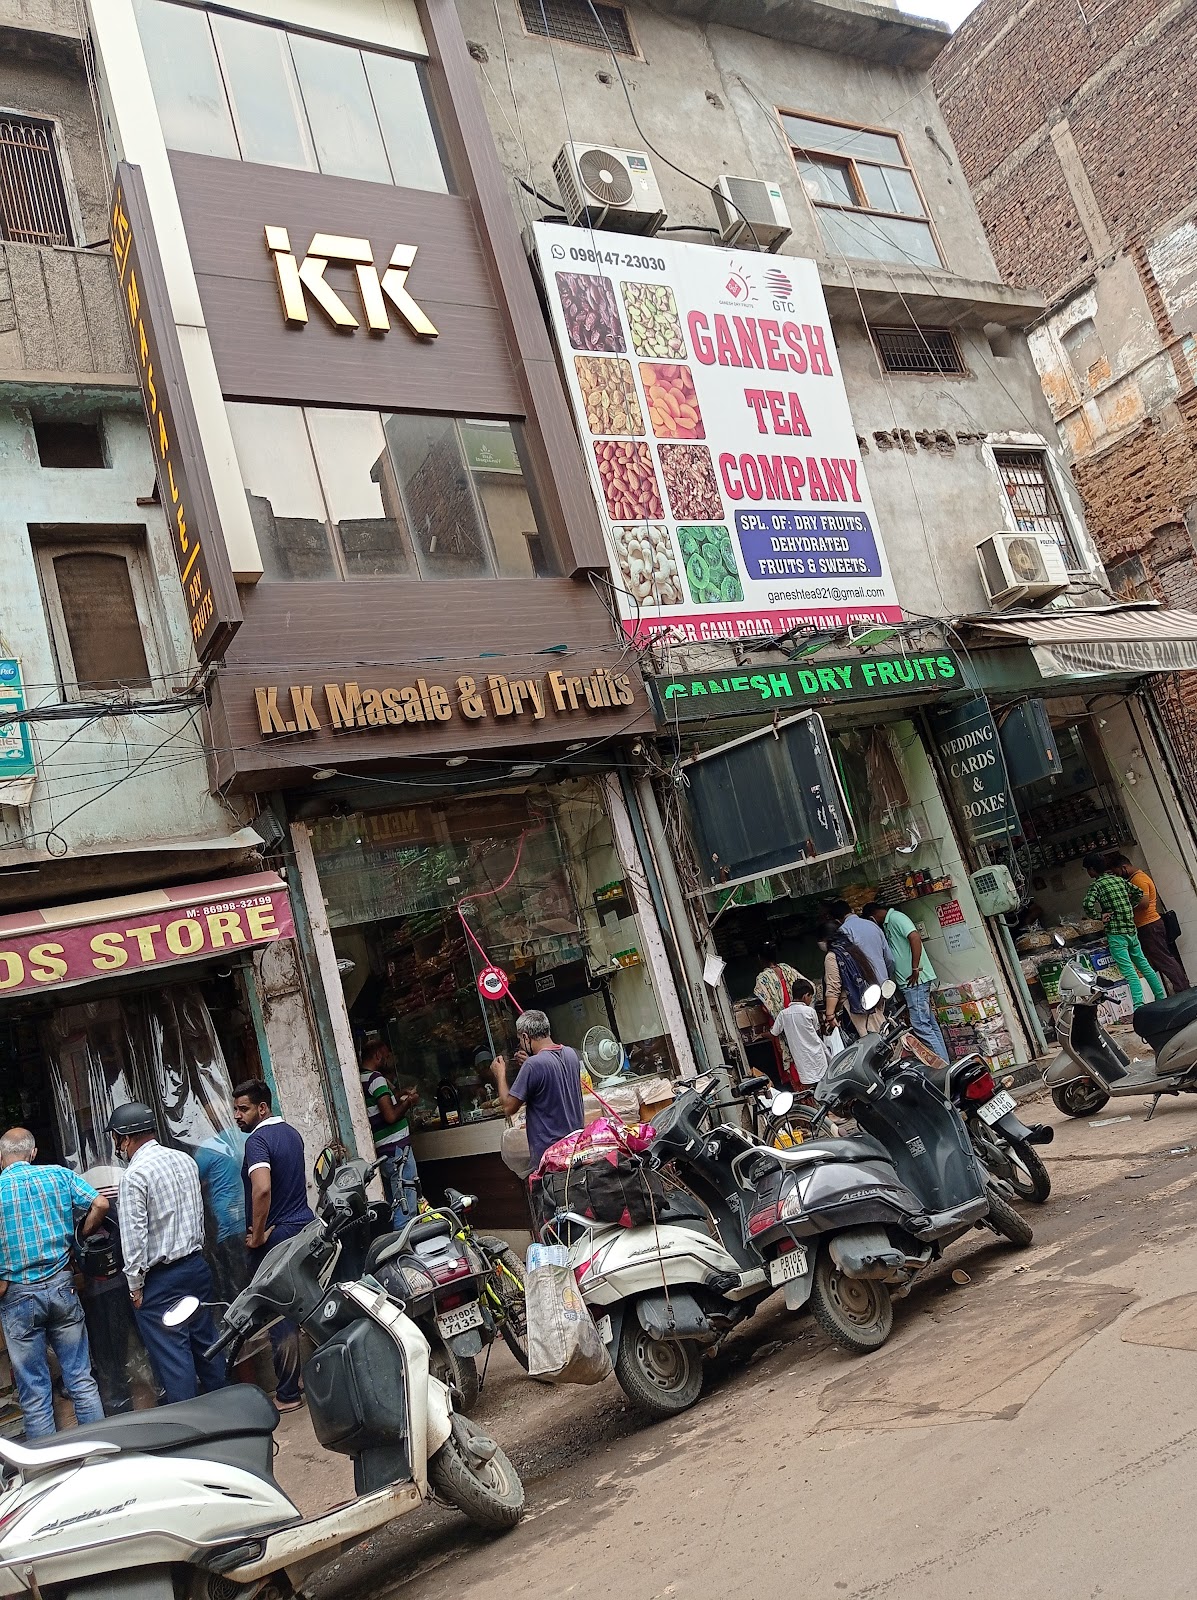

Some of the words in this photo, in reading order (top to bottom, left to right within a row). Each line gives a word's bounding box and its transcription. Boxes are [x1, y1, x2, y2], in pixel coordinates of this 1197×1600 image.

[569, 247, 666, 271] 098147-23030
[772, 300, 796, 313] GTC
[687, 309, 834, 377] GANESH
[127, 268, 188, 554] MASALE
[744, 387, 812, 437] TEA
[718, 452, 862, 502] COMPANY
[740, 515, 769, 530] SPL.
[771, 515, 792, 530] OF:
[794, 515, 818, 531] DRY
[820, 516, 867, 532] FRUITS,
[770, 537, 849, 552] DEHYDRATED
[758, 558, 805, 574] FRUITS
[807, 558, 819, 573] &
[819, 558, 871, 573] SWEETS.
[190, 569, 202, 608] DRY
[767, 586, 885, 604] ganeshtea921@gmail.com
[192, 588, 213, 643] FRUITS
[799, 665, 853, 695] DRY
[860, 655, 957, 687] FRUITS
[253, 686, 321, 736] K.K
[322, 678, 453, 730] Masale
[455, 675, 487, 720] &
[486, 673, 547, 721] Dry
[546, 668, 635, 713] Fruits
[940, 725, 993, 758] WEDDING
[950, 749, 996, 778] CARDS
[972, 776, 985, 792] &
[962, 792, 1005, 820] BOXES
[186, 909, 201, 919] M:
[202, 896, 272, 916] 86998-32199
[89, 903, 281, 971] STORE
[839, 1187, 879, 1202] Activa
[446, 1316, 477, 1333] 7135
